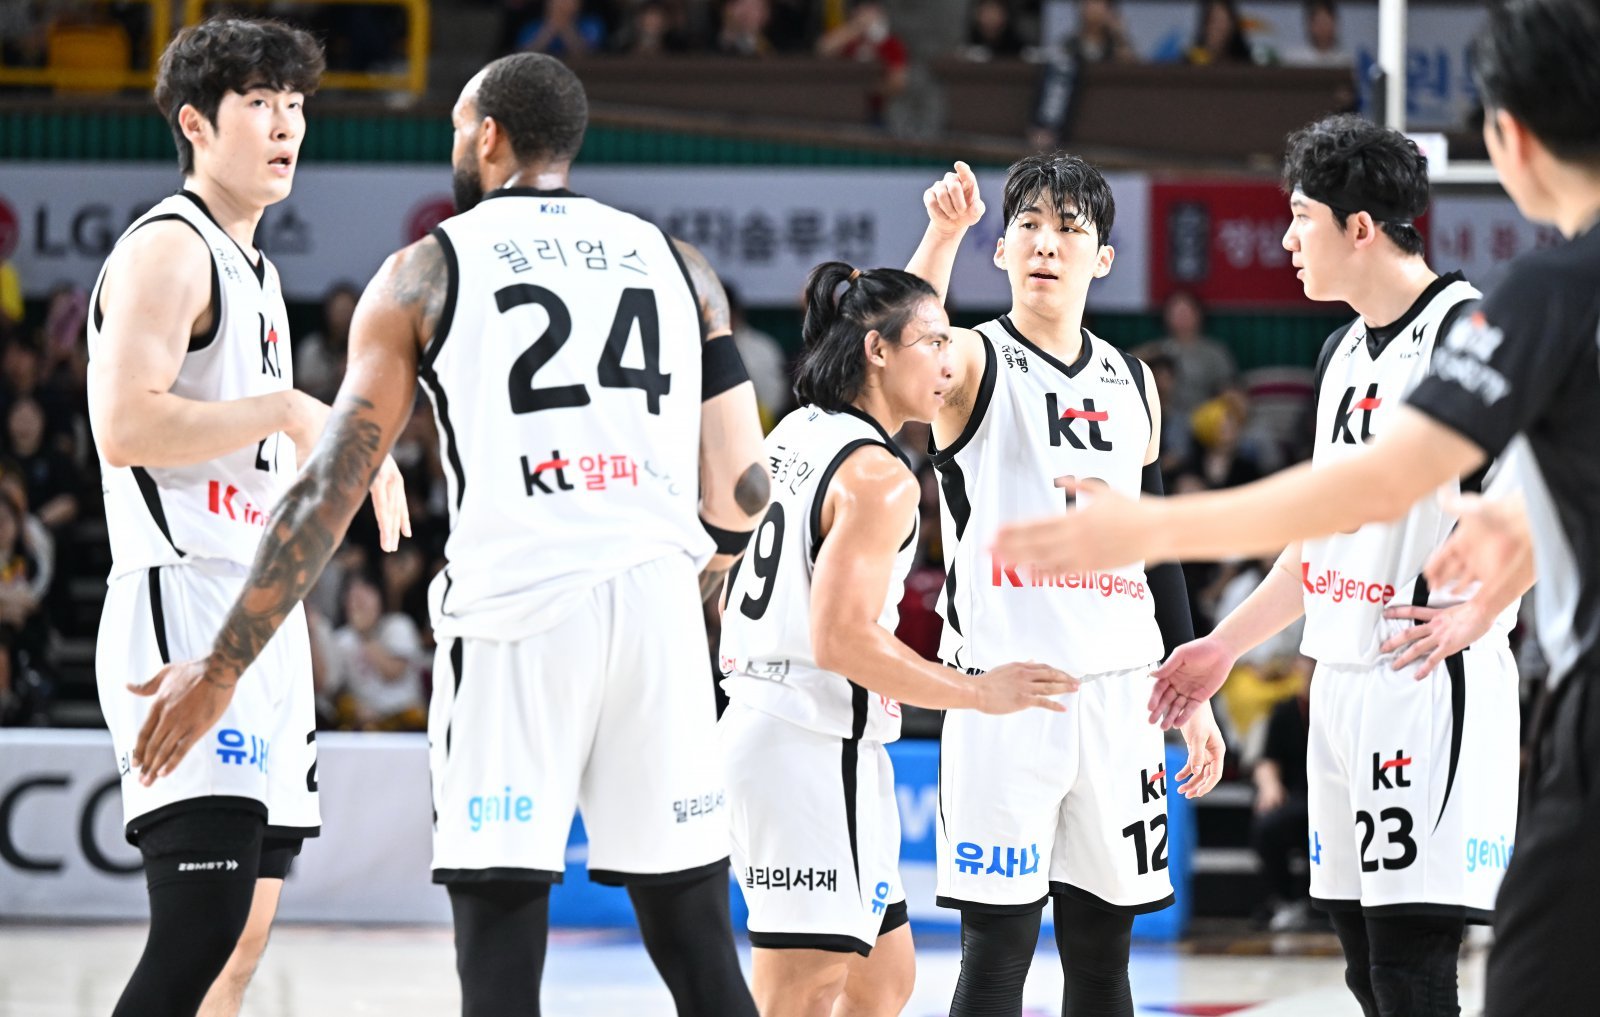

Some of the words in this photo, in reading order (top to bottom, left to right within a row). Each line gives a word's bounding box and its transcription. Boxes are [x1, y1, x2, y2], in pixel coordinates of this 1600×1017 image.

[494, 238, 648, 275] 윌리엄스
[494, 283, 671, 415] 24
[1045, 393, 1112, 451] kt
[1332, 383, 1382, 445] kt
[520, 450, 574, 496] kt
[579, 454, 638, 490] 알파
[208, 480, 238, 520] K
[1141, 763, 1167, 804] kt
[1373, 749, 1412, 791] kt
[469, 786, 533, 832] genie
[954, 841, 1040, 878] 유사나
[1122, 813, 1168, 876] 12
[1355, 807, 1418, 873] 23
